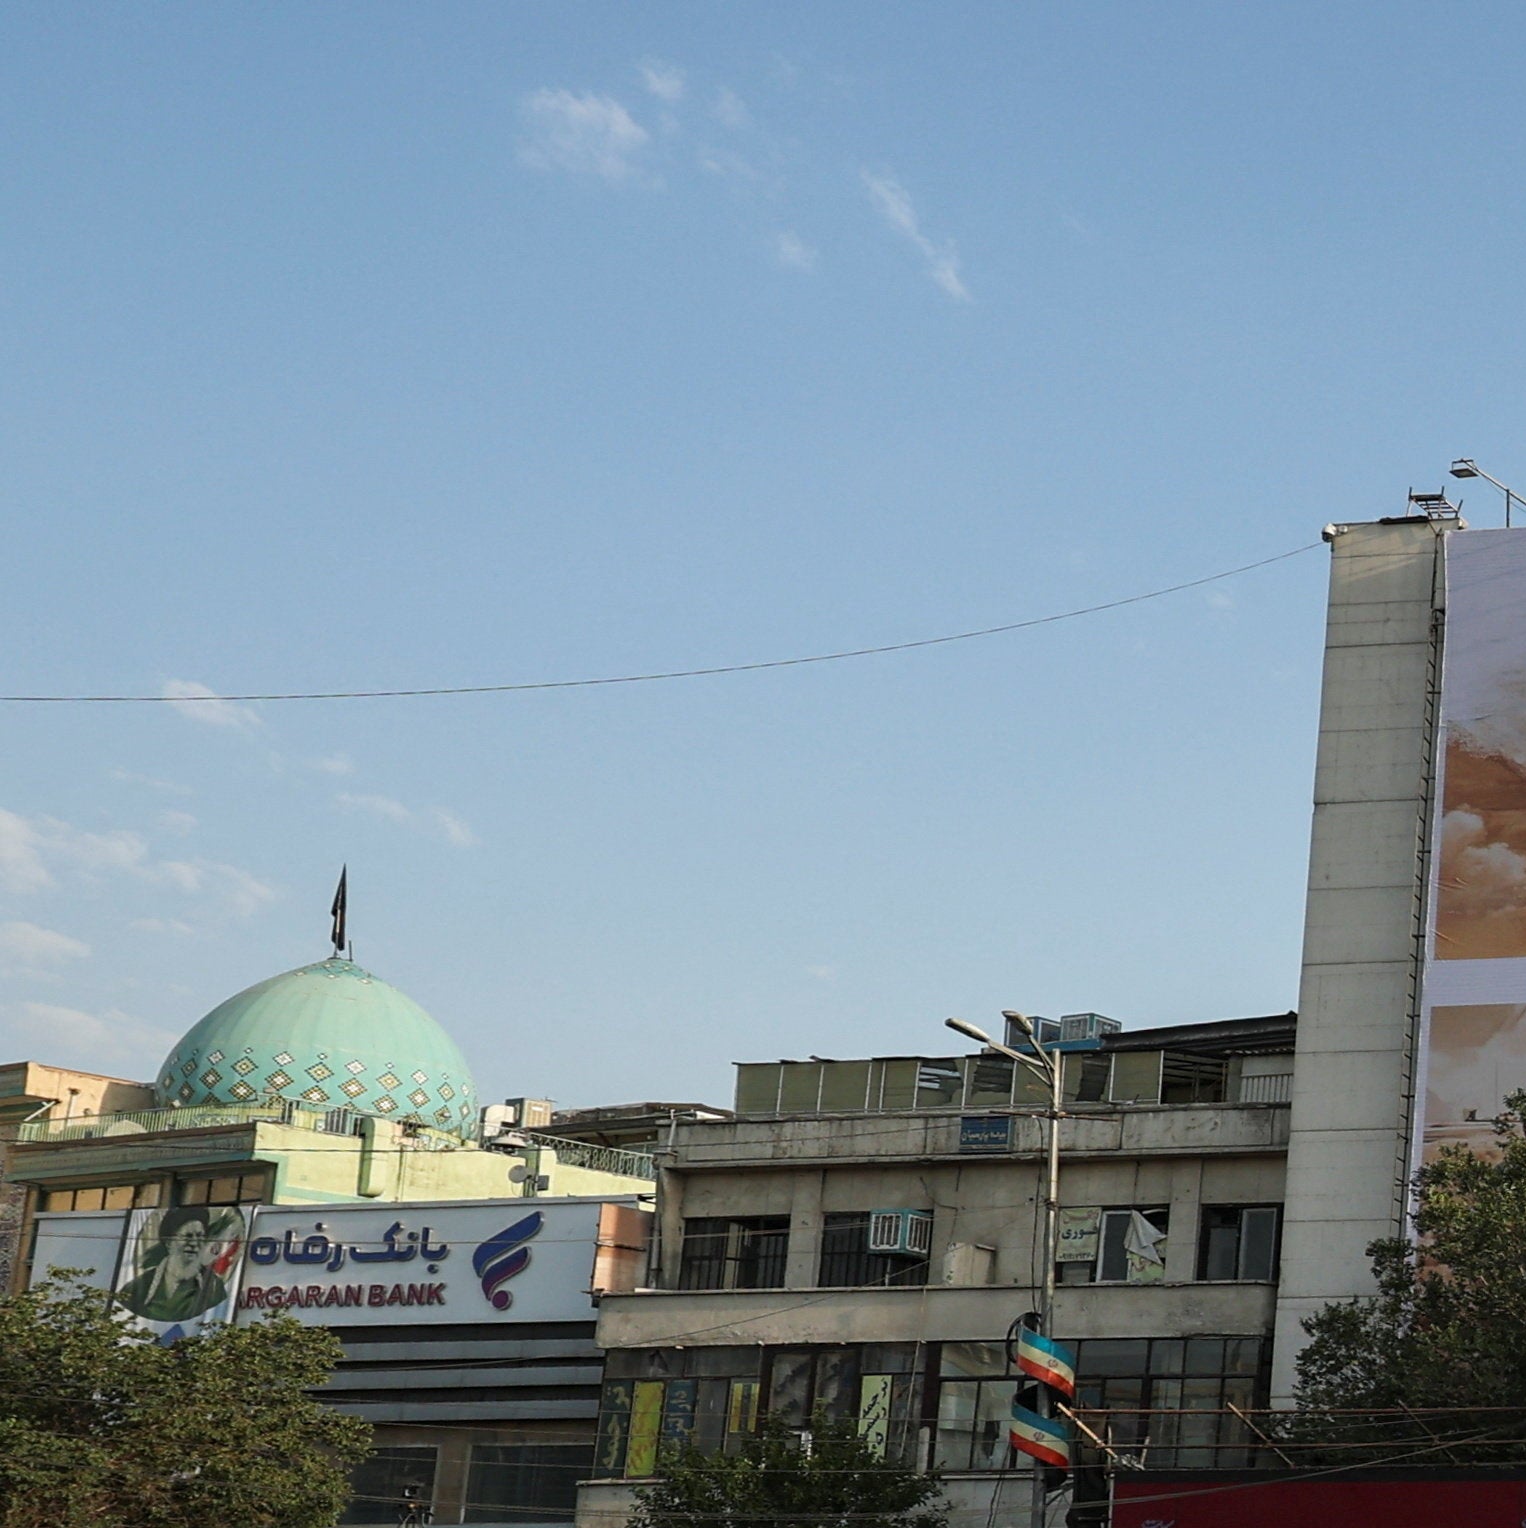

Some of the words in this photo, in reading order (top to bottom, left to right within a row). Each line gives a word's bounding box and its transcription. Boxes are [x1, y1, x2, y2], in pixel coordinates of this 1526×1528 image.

[250, 1222, 345, 1273] رفاه
[350, 1221, 448, 1274] بانک
[368, 1282, 447, 1307] BANK
